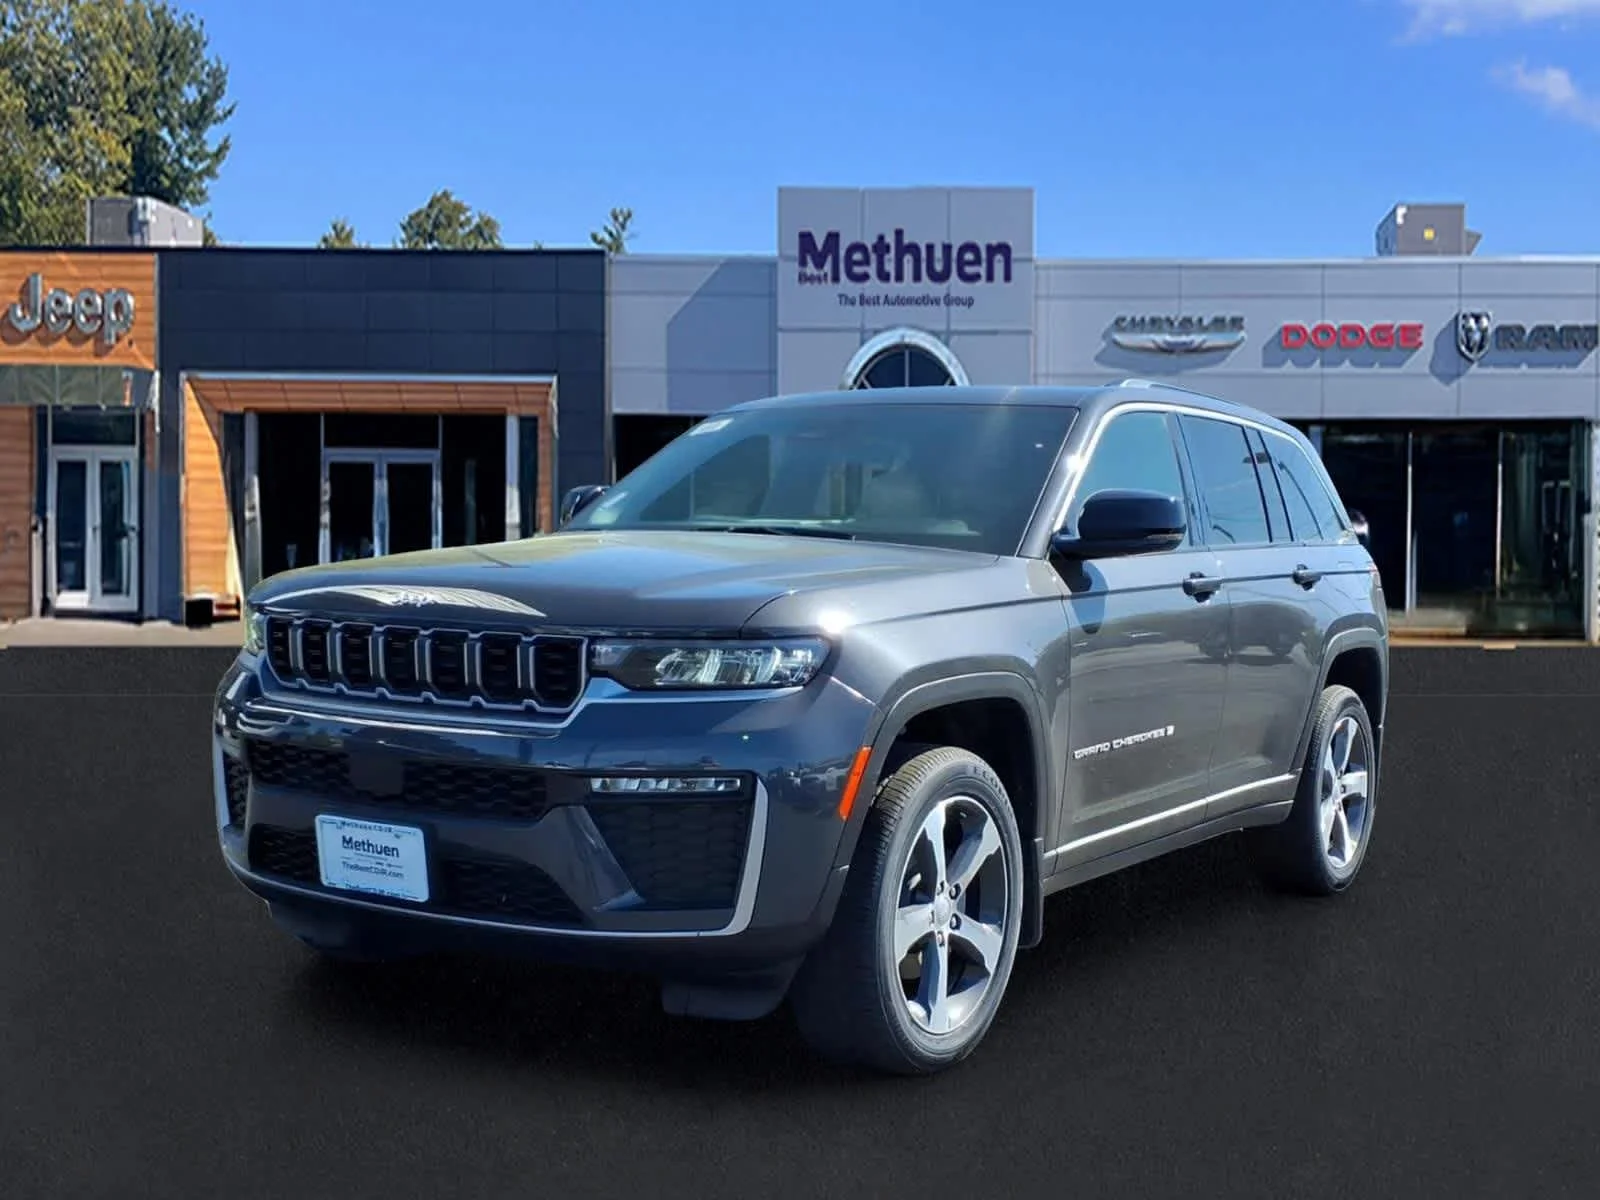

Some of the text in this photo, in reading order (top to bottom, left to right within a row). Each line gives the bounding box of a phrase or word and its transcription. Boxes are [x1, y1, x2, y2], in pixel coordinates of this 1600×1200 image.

[798, 228, 1013, 284] Methuen
[9, 272, 135, 345] Jeep
[838, 293, 975, 309] The Best Automotive Group
[1114, 315, 1245, 332] CHRYSLER
[1281, 323, 1424, 350] DODGE
[1495, 324, 1598, 352] RAM
[1073, 727, 1166, 759] GRAND CHEROKEE
[341, 835, 400, 858] Methuen
